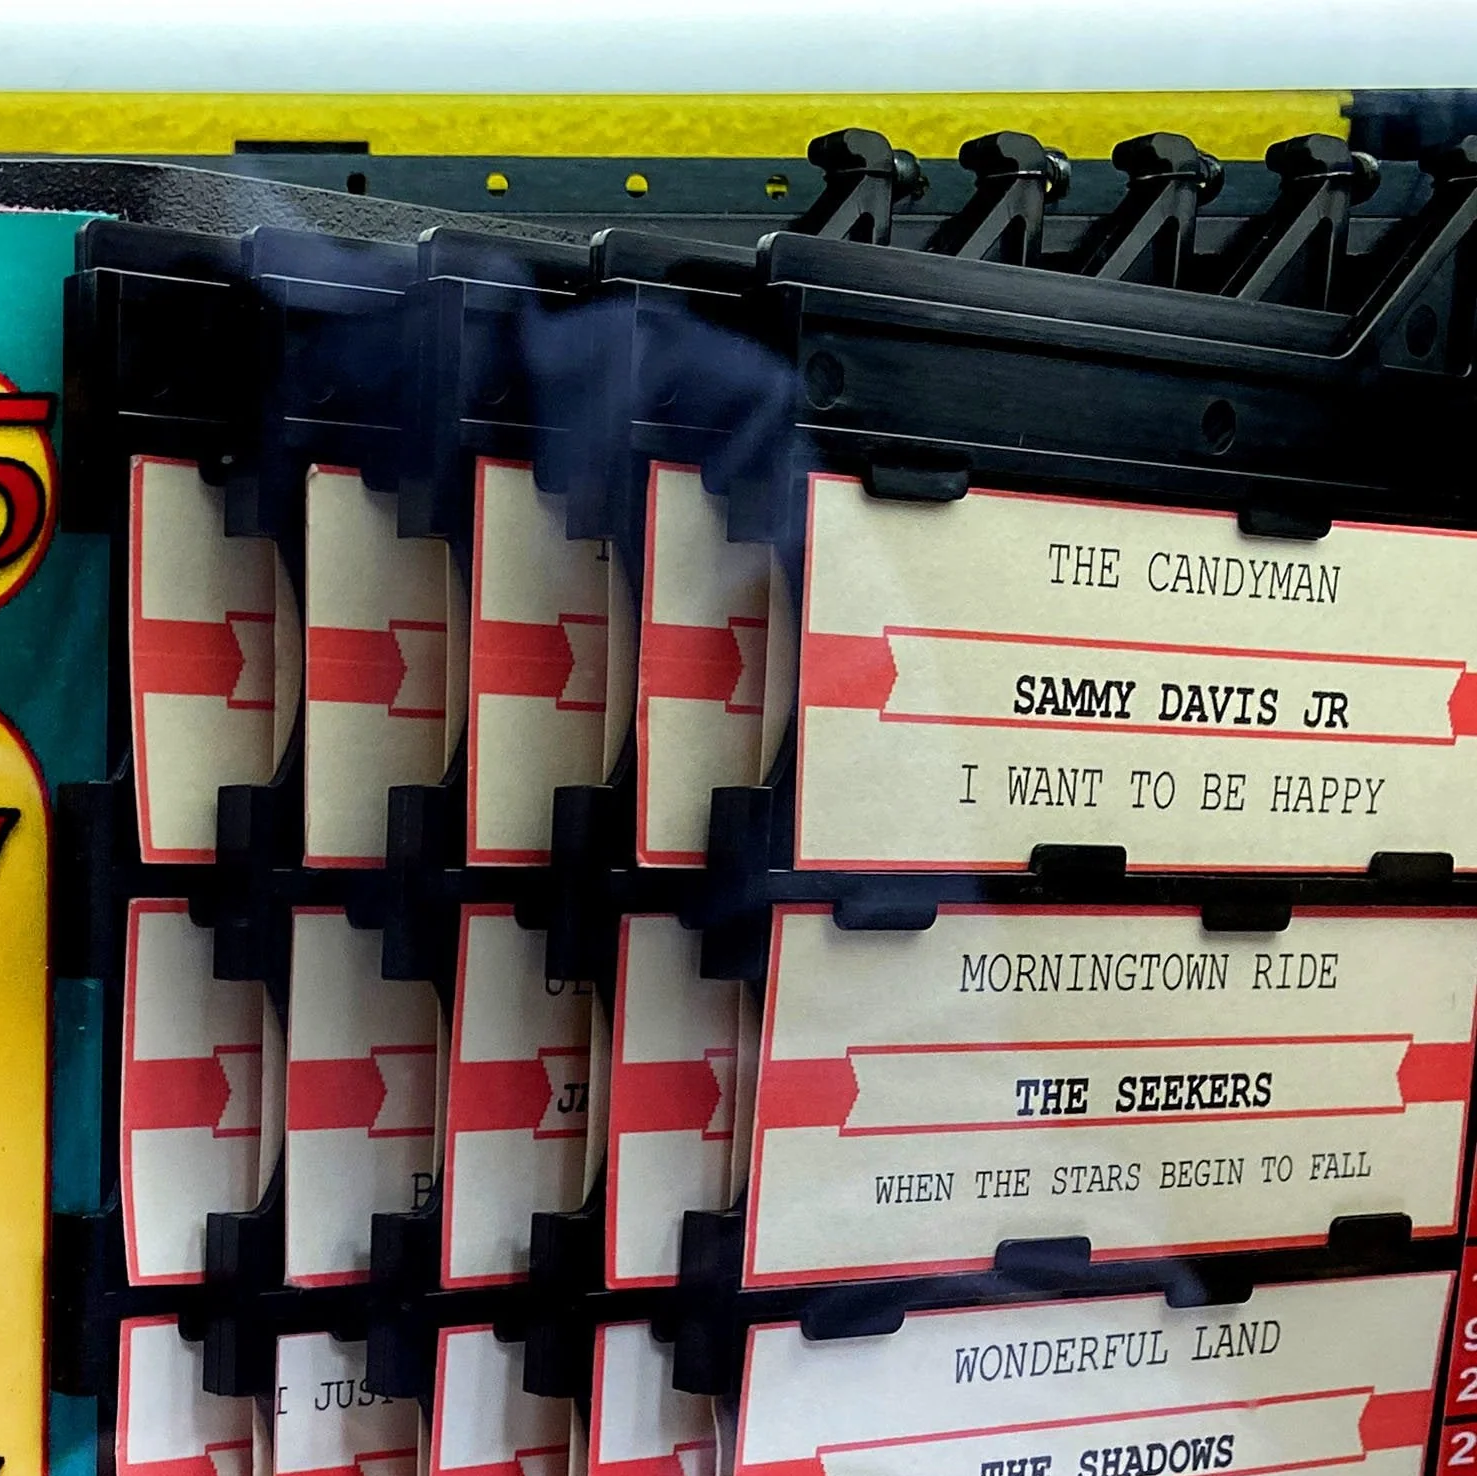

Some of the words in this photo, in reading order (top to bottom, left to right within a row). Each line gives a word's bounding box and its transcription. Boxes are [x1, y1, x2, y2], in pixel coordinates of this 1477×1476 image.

[1048, 543, 1120, 589] THE
[1148, 551, 1341, 604] CANDYMAN
[1013, 674, 1137, 720] SAMMY
[1158, 682, 1279, 726] DAVIS
[1303, 690, 1349, 729] JR
[959, 764, 979, 804] I
[1007, 765, 1103, 808] WANT
[1130, 770, 1176, 810] TO
[1200, 772, 1246, 811] BE
[1270, 775, 1386, 815] HAPPY
[959, 953, 1230, 993] MORNINGTOWN
[1251, 953, 1339, 990] RIDE
[1016, 1077, 1090, 1117] THE
[1115, 1071, 1273, 1113] SEEKERS
[875, 1172, 955, 1205] WHEN
[975, 1168, 1031, 1199] THE
[1051, 1162, 1141, 1195] STARS
[1159, 1157, 1245, 1190] BEGIN
[1261, 1155, 1293, 1183] TO
[1309, 1151, 1372, 1181] FALL
[955, 1329, 1169, 1384] WONDERFUL
[1191, 1320, 1281, 1361] LAND
[314, 1380, 395, 1412] JUS
